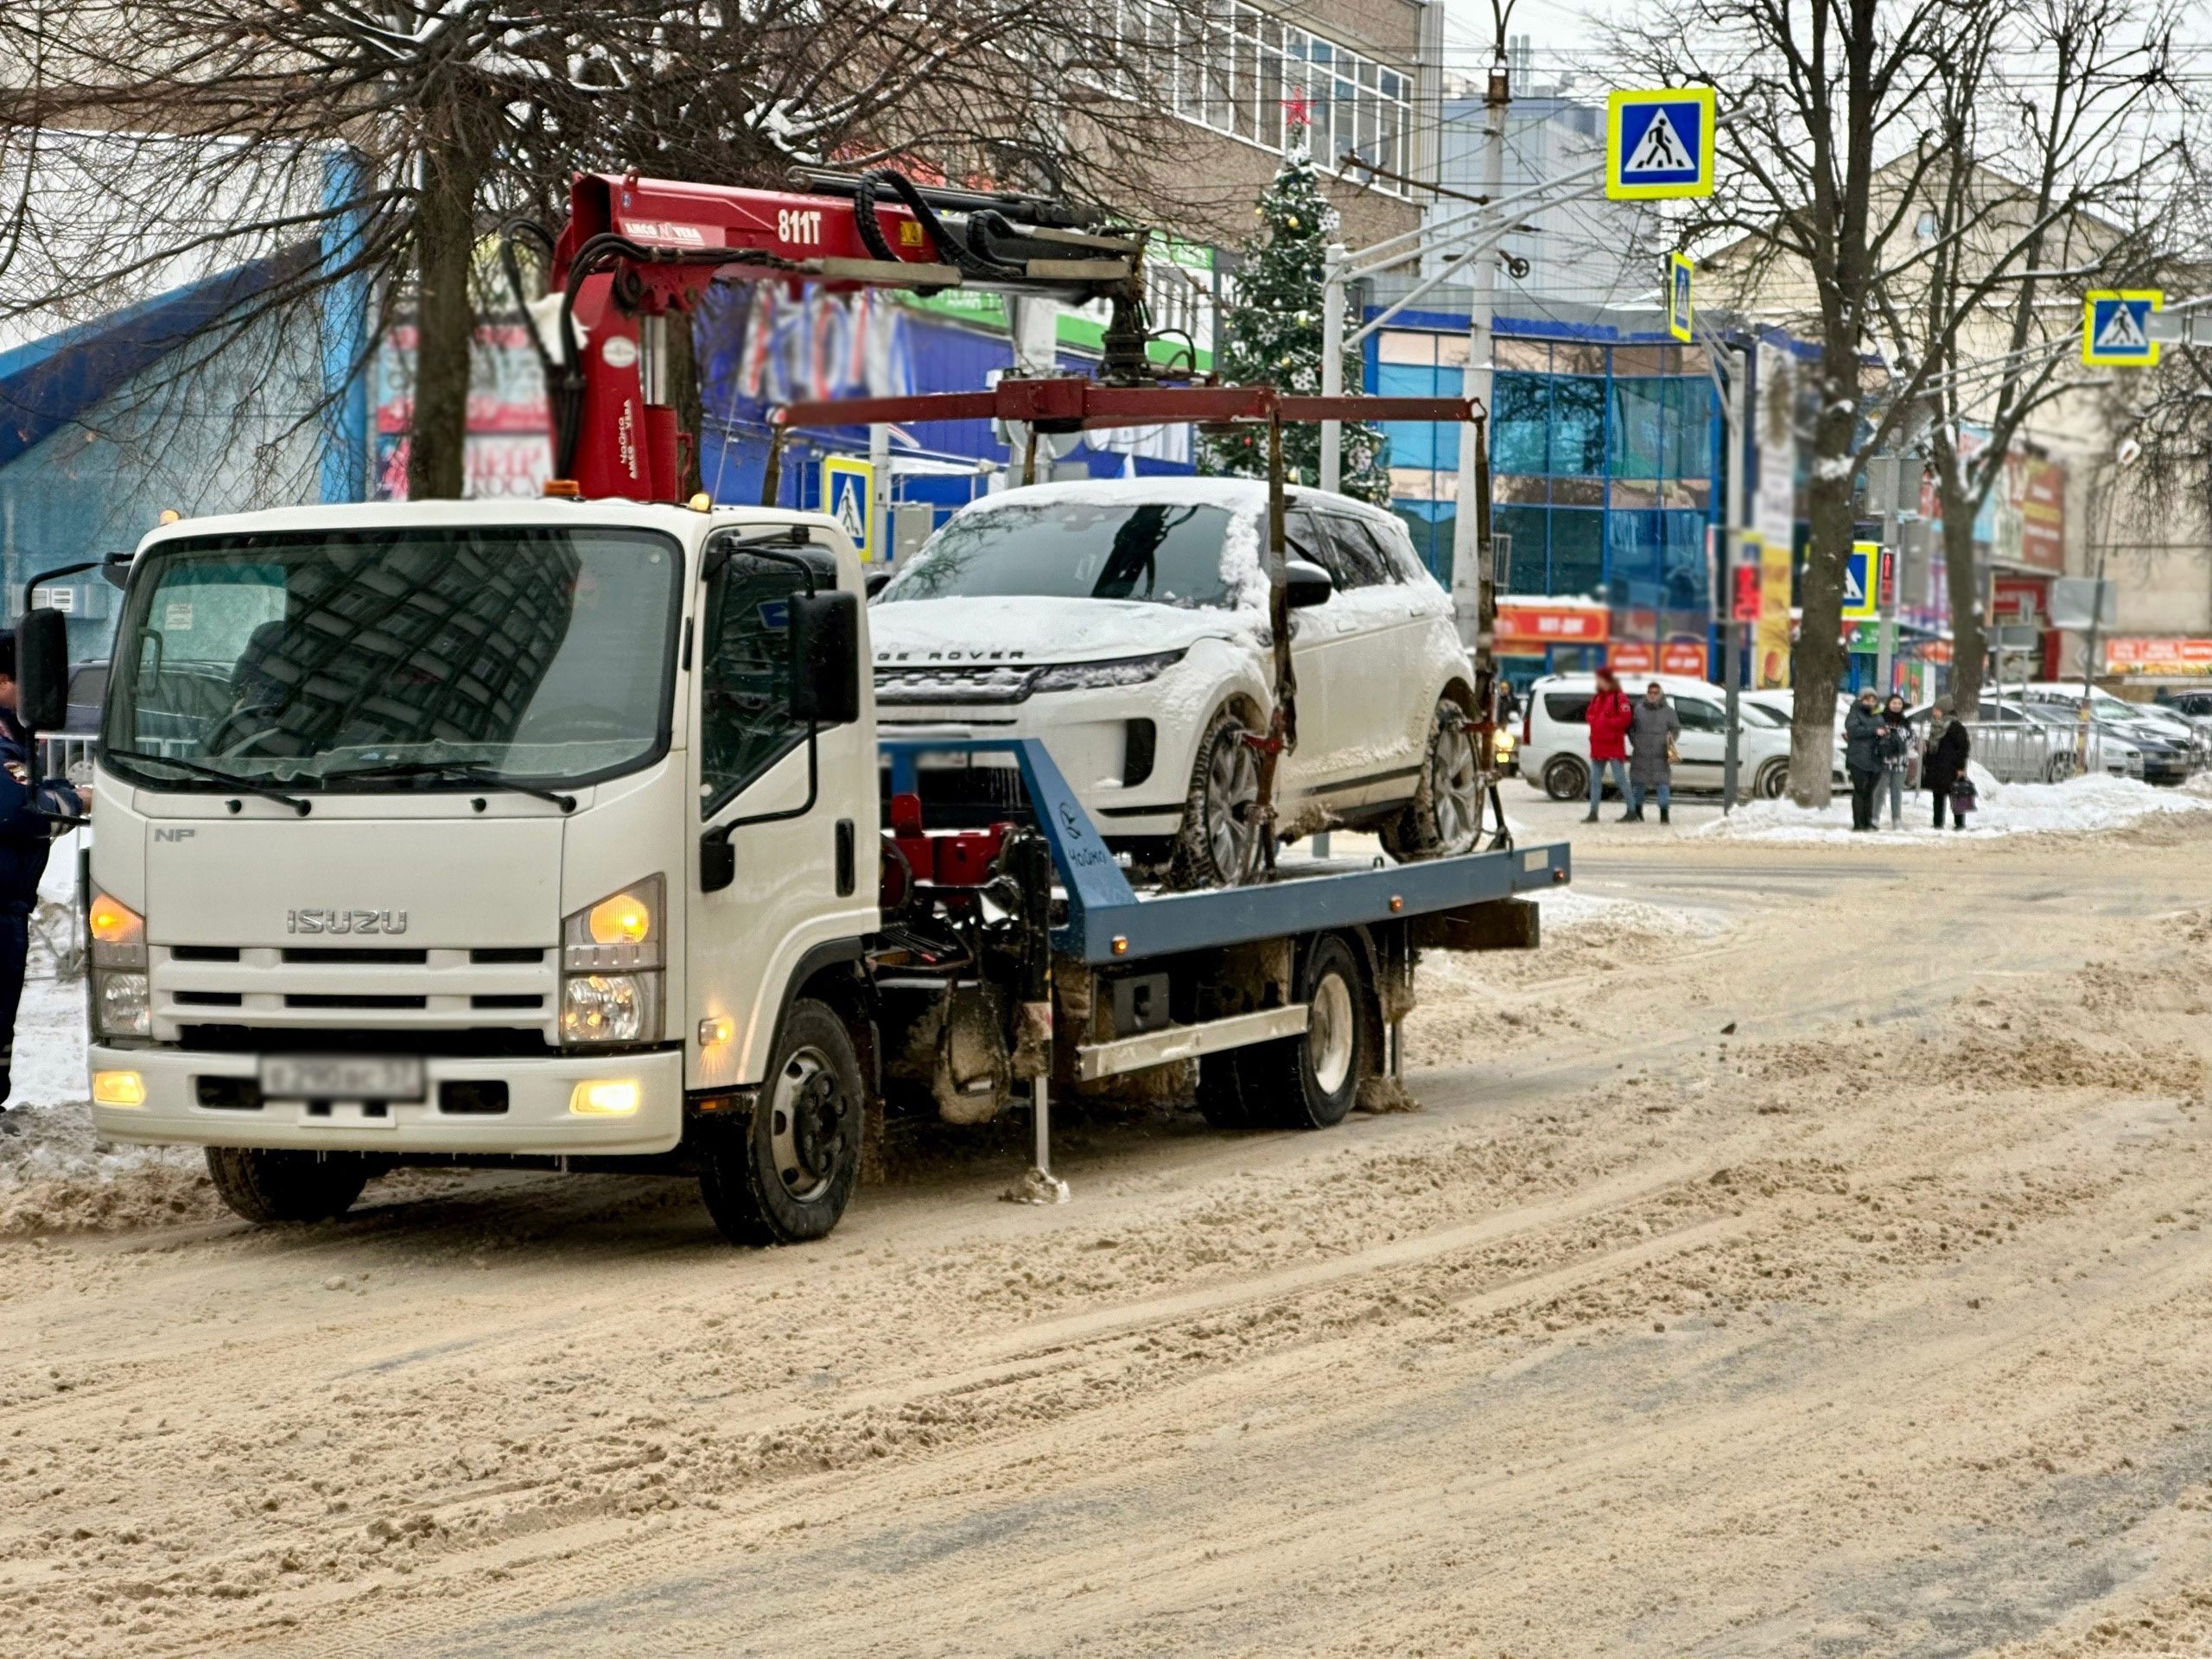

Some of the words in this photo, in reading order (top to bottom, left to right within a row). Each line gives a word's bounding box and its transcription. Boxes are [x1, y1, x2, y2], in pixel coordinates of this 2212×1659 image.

[778, 208, 822, 245] 811T
[927, 650, 1025, 661] ROVER
[154, 829, 195, 842] NP
[287, 908, 407, 935] ISUZU
